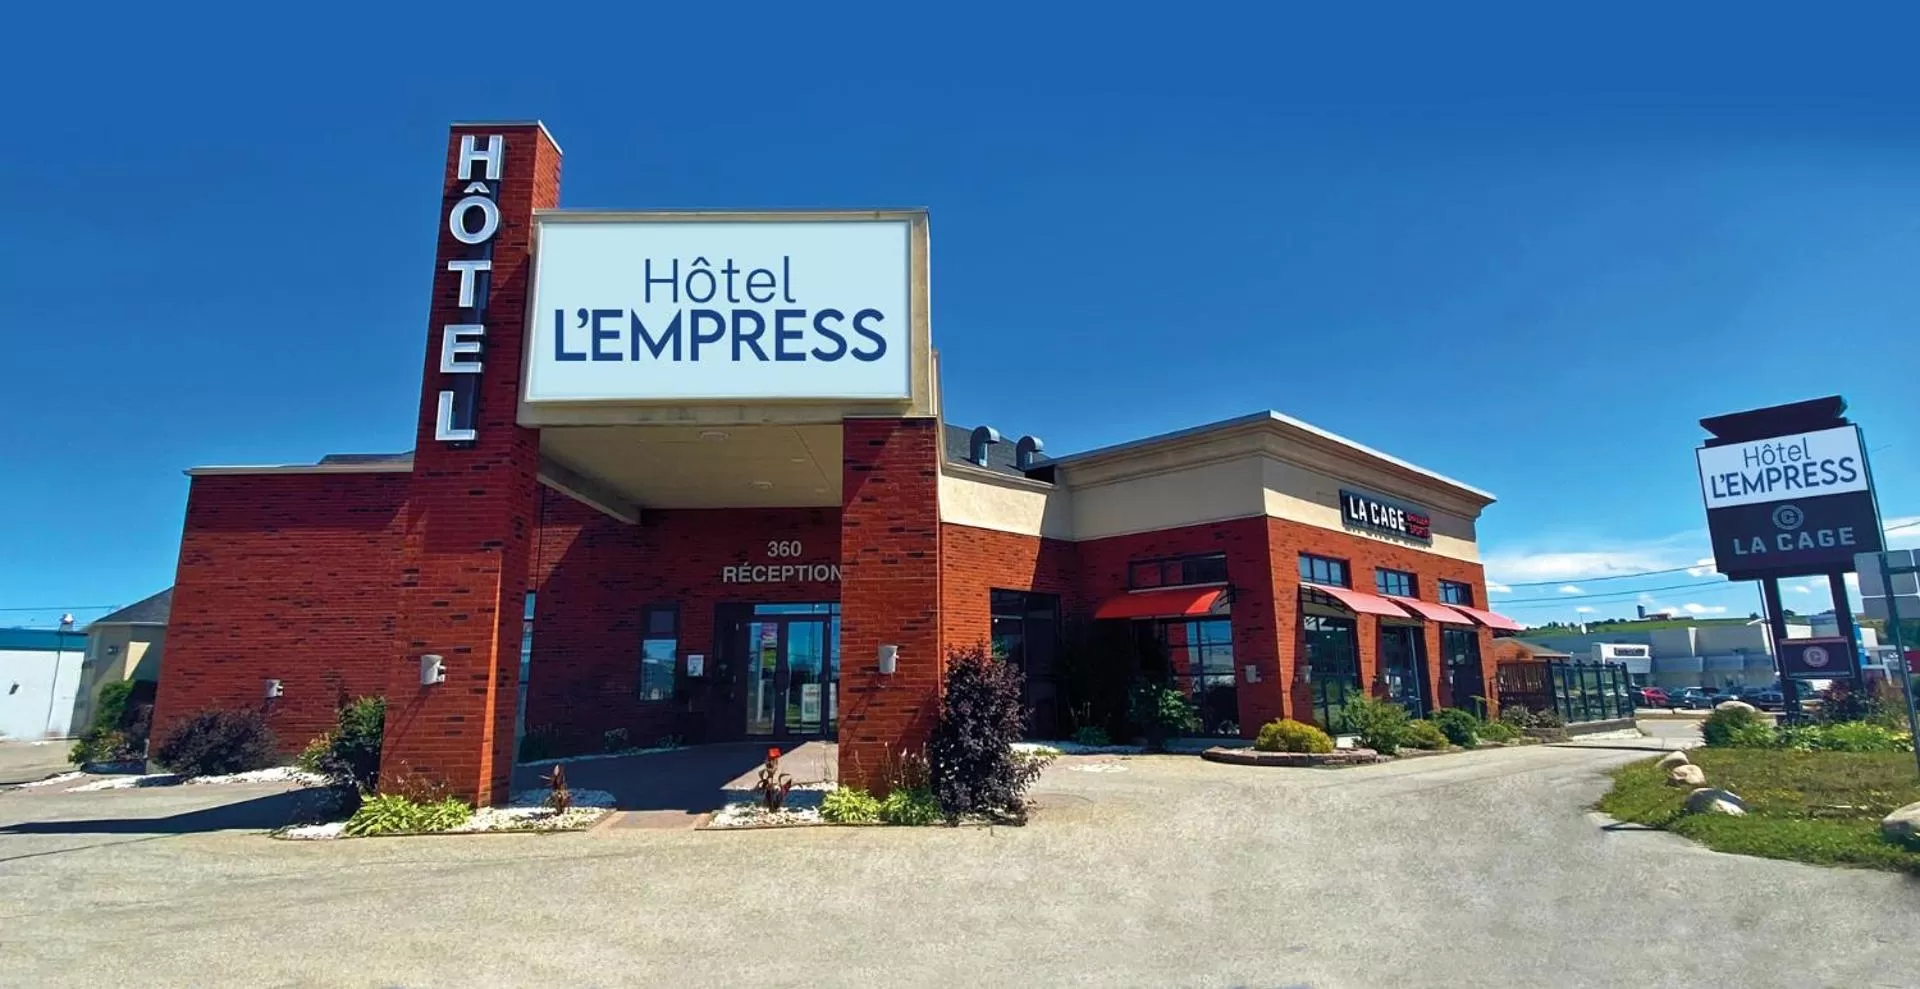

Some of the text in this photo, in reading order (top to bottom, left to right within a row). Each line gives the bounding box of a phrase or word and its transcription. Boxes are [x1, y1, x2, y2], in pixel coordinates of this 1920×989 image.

[435, 134, 503, 442] HÔTEL
[644, 256, 797, 303] Hôtel
[555, 308, 887, 362] L'EMPRESS
[1743, 437, 1812, 468] Hôtel
[1710, 457, 1857, 499] L'EMPRESS
[1350, 496, 1367, 522] LA
[1370, 502, 1406, 531] CAGE
[767, 540, 802, 557] 360
[1733, 527, 1857, 555] LA CAGE
[723, 562, 842, 583] RÉCEPTION
